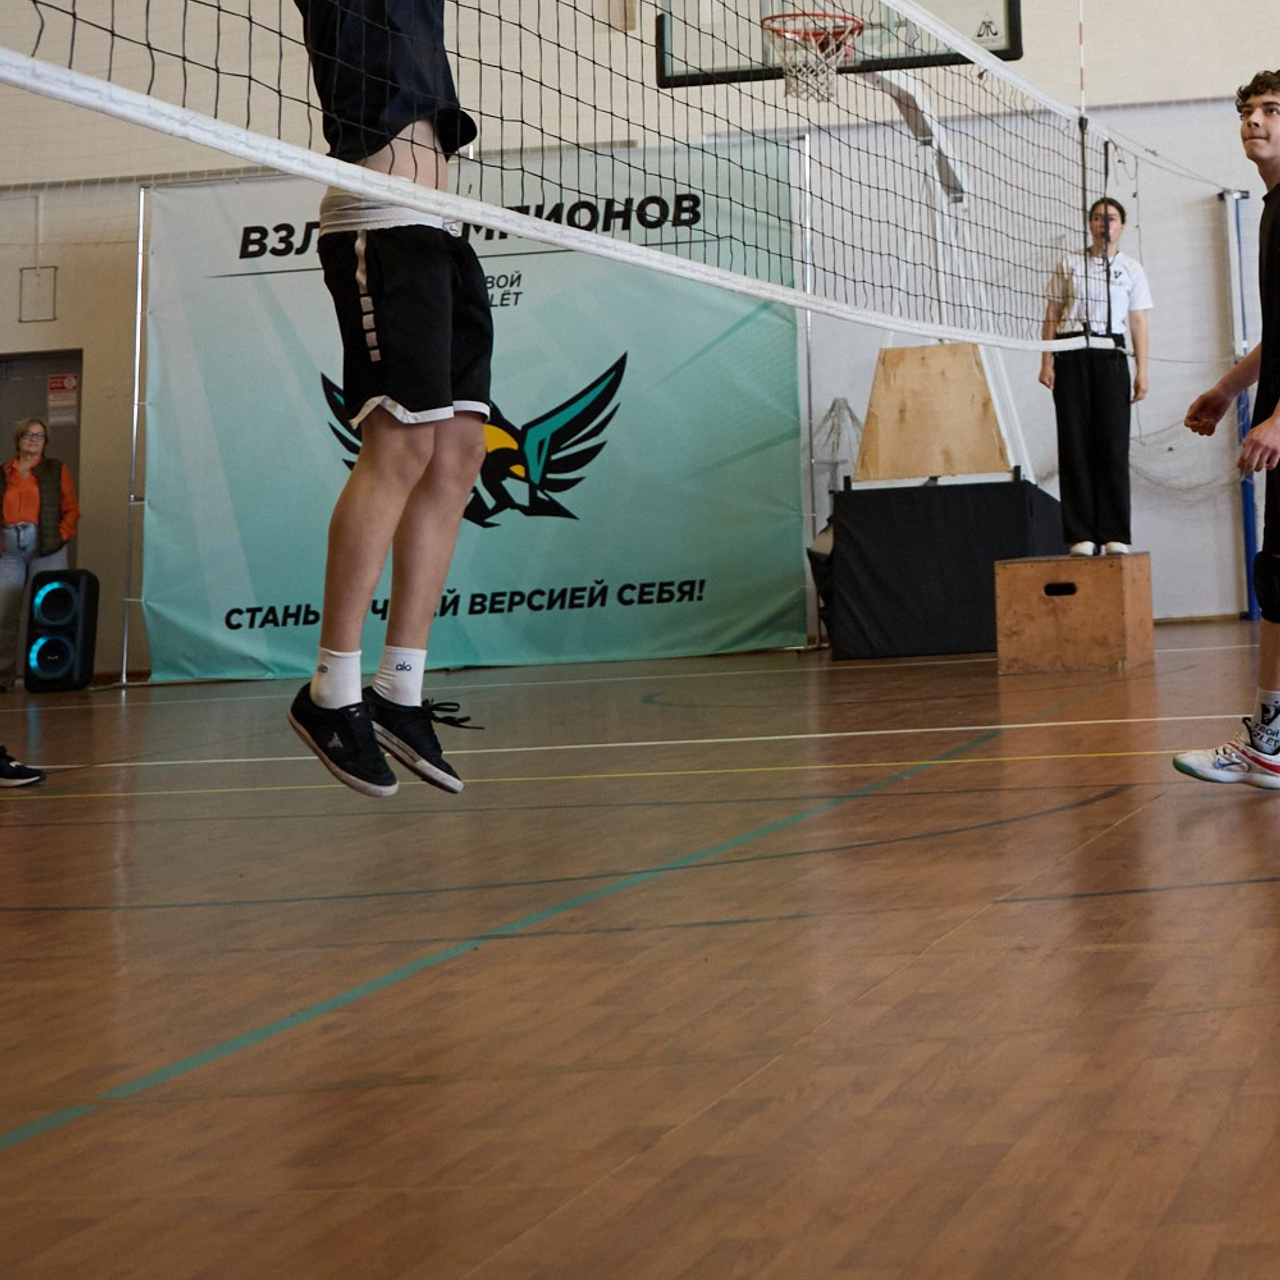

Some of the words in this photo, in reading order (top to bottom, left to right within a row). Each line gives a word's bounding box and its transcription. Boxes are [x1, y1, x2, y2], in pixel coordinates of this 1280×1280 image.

[239, 221, 320, 260] ВЗЛ
[485, 270, 522, 289] ВОЙ
[224, 603, 320, 630] СТАНЬ
[468, 579, 609, 615] ВЕРСИЕЙ
[616, 578, 706, 606] СЕБЯ!
[396, 661, 411, 671] alo
